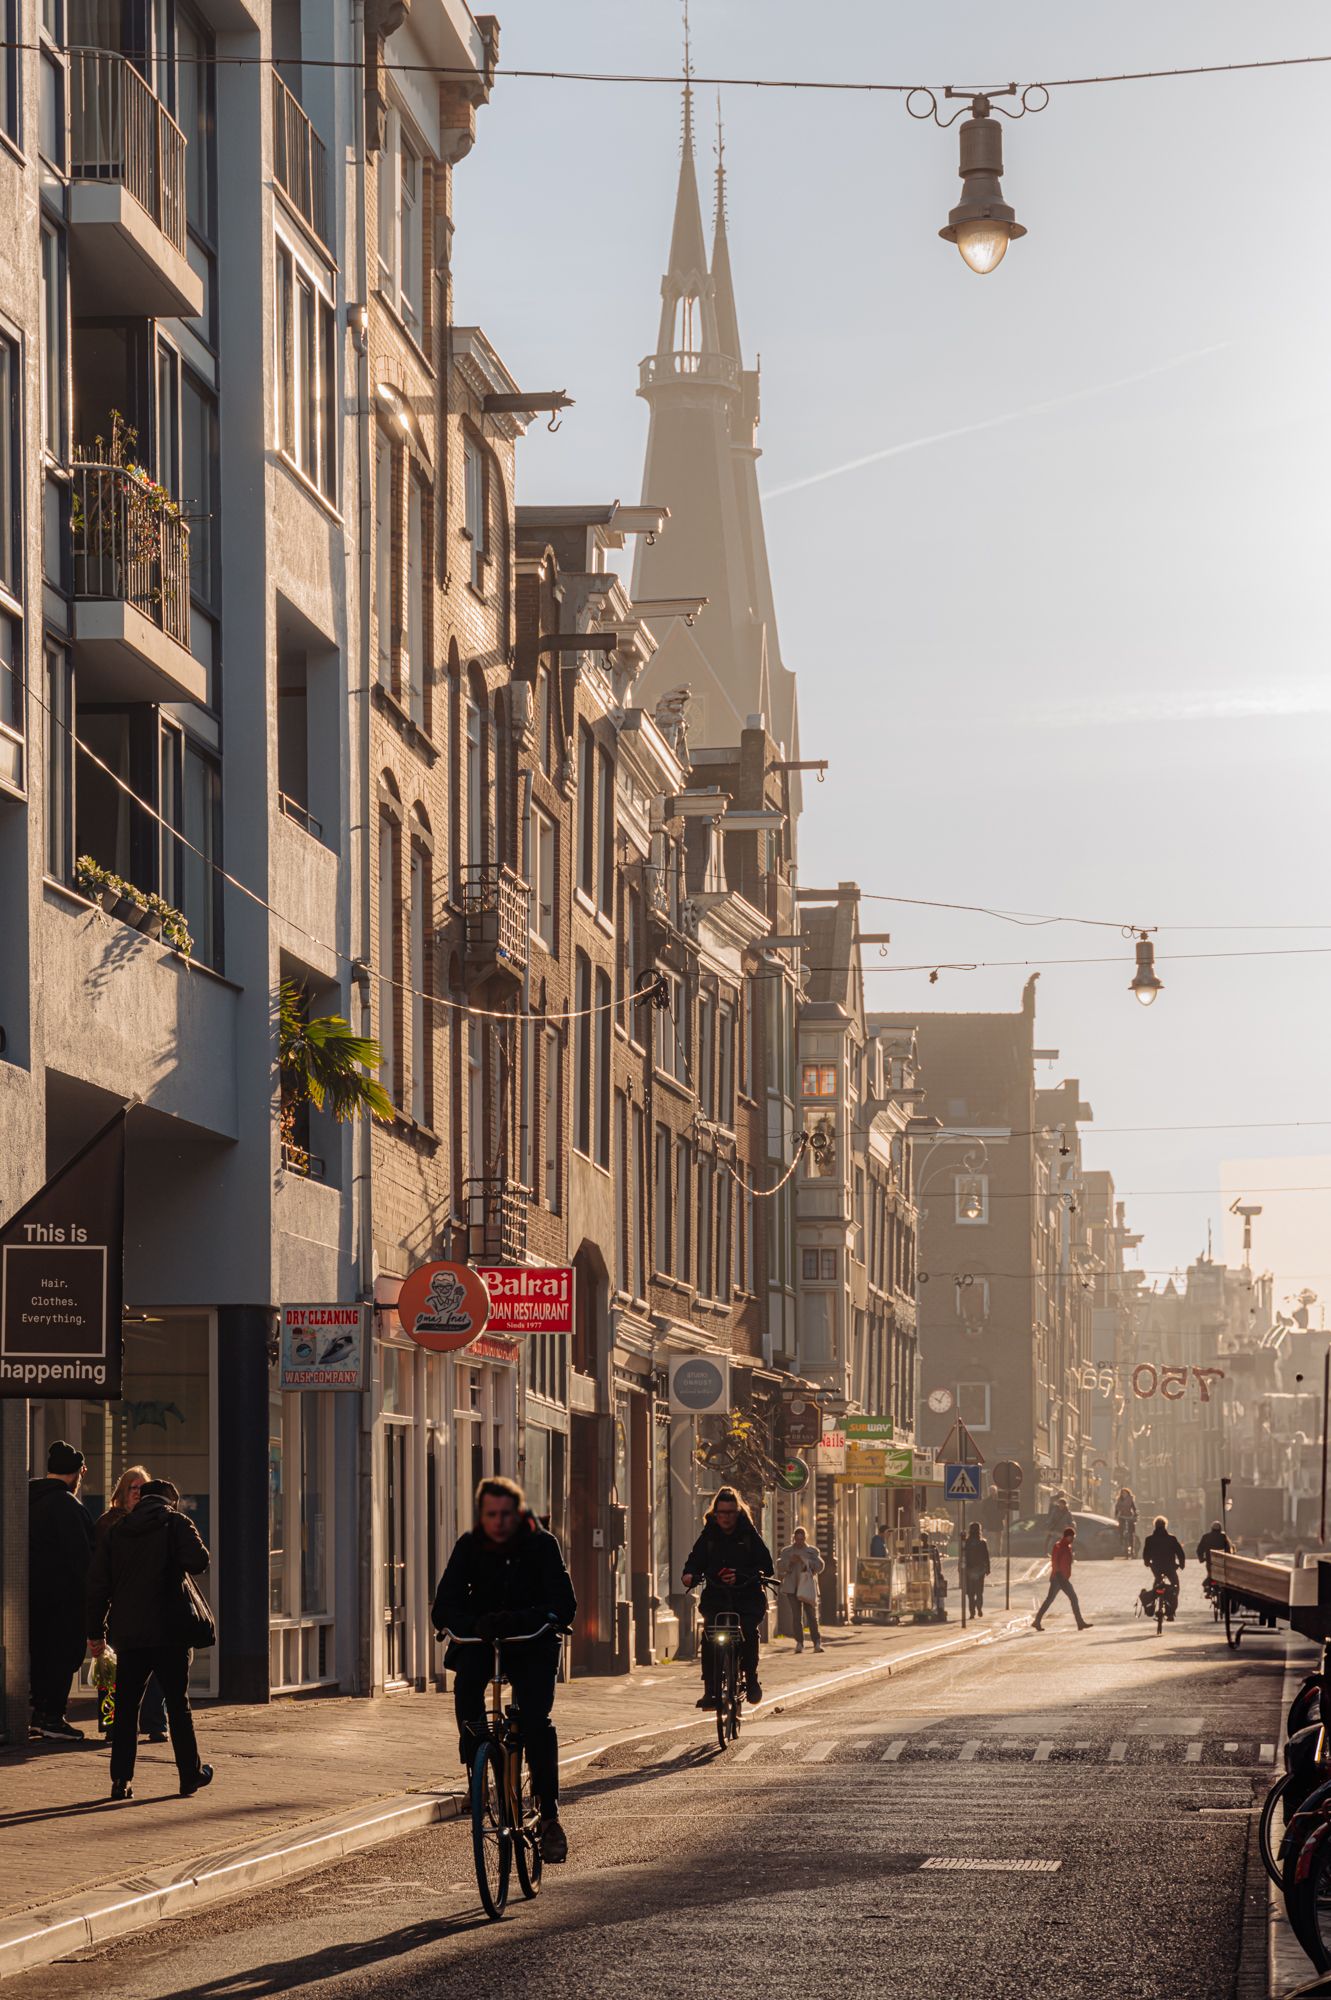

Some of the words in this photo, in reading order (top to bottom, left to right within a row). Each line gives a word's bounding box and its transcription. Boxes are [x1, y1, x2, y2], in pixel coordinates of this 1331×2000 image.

[23, 1223, 66, 1243] This
[71, 1223, 88, 1243] is
[41, 1278, 69, 1288] Hair.
[481, 1271, 569, 1302] Balraj
[31, 1296, 78, 1307] Clothes.
[286, 1309, 306, 1325] DRY
[308, 1309, 359, 1325] CLEANING
[489, 1302, 512, 1320] DIAN
[513, 1302, 569, 1321] RESTAURANT
[21, 1313, 87, 1326] Everything.
[506, 1321, 525, 1329] Sinds
[526, 1321, 542, 1329] 1977
[0, 1359, 107, 1385] happening
[285, 1370, 311, 1384] WASH
[312, 1370, 358, 1384] COMPANY
[849, 1423, 892, 1433] SUBWAY
[819, 1433, 845, 1448] Nails
